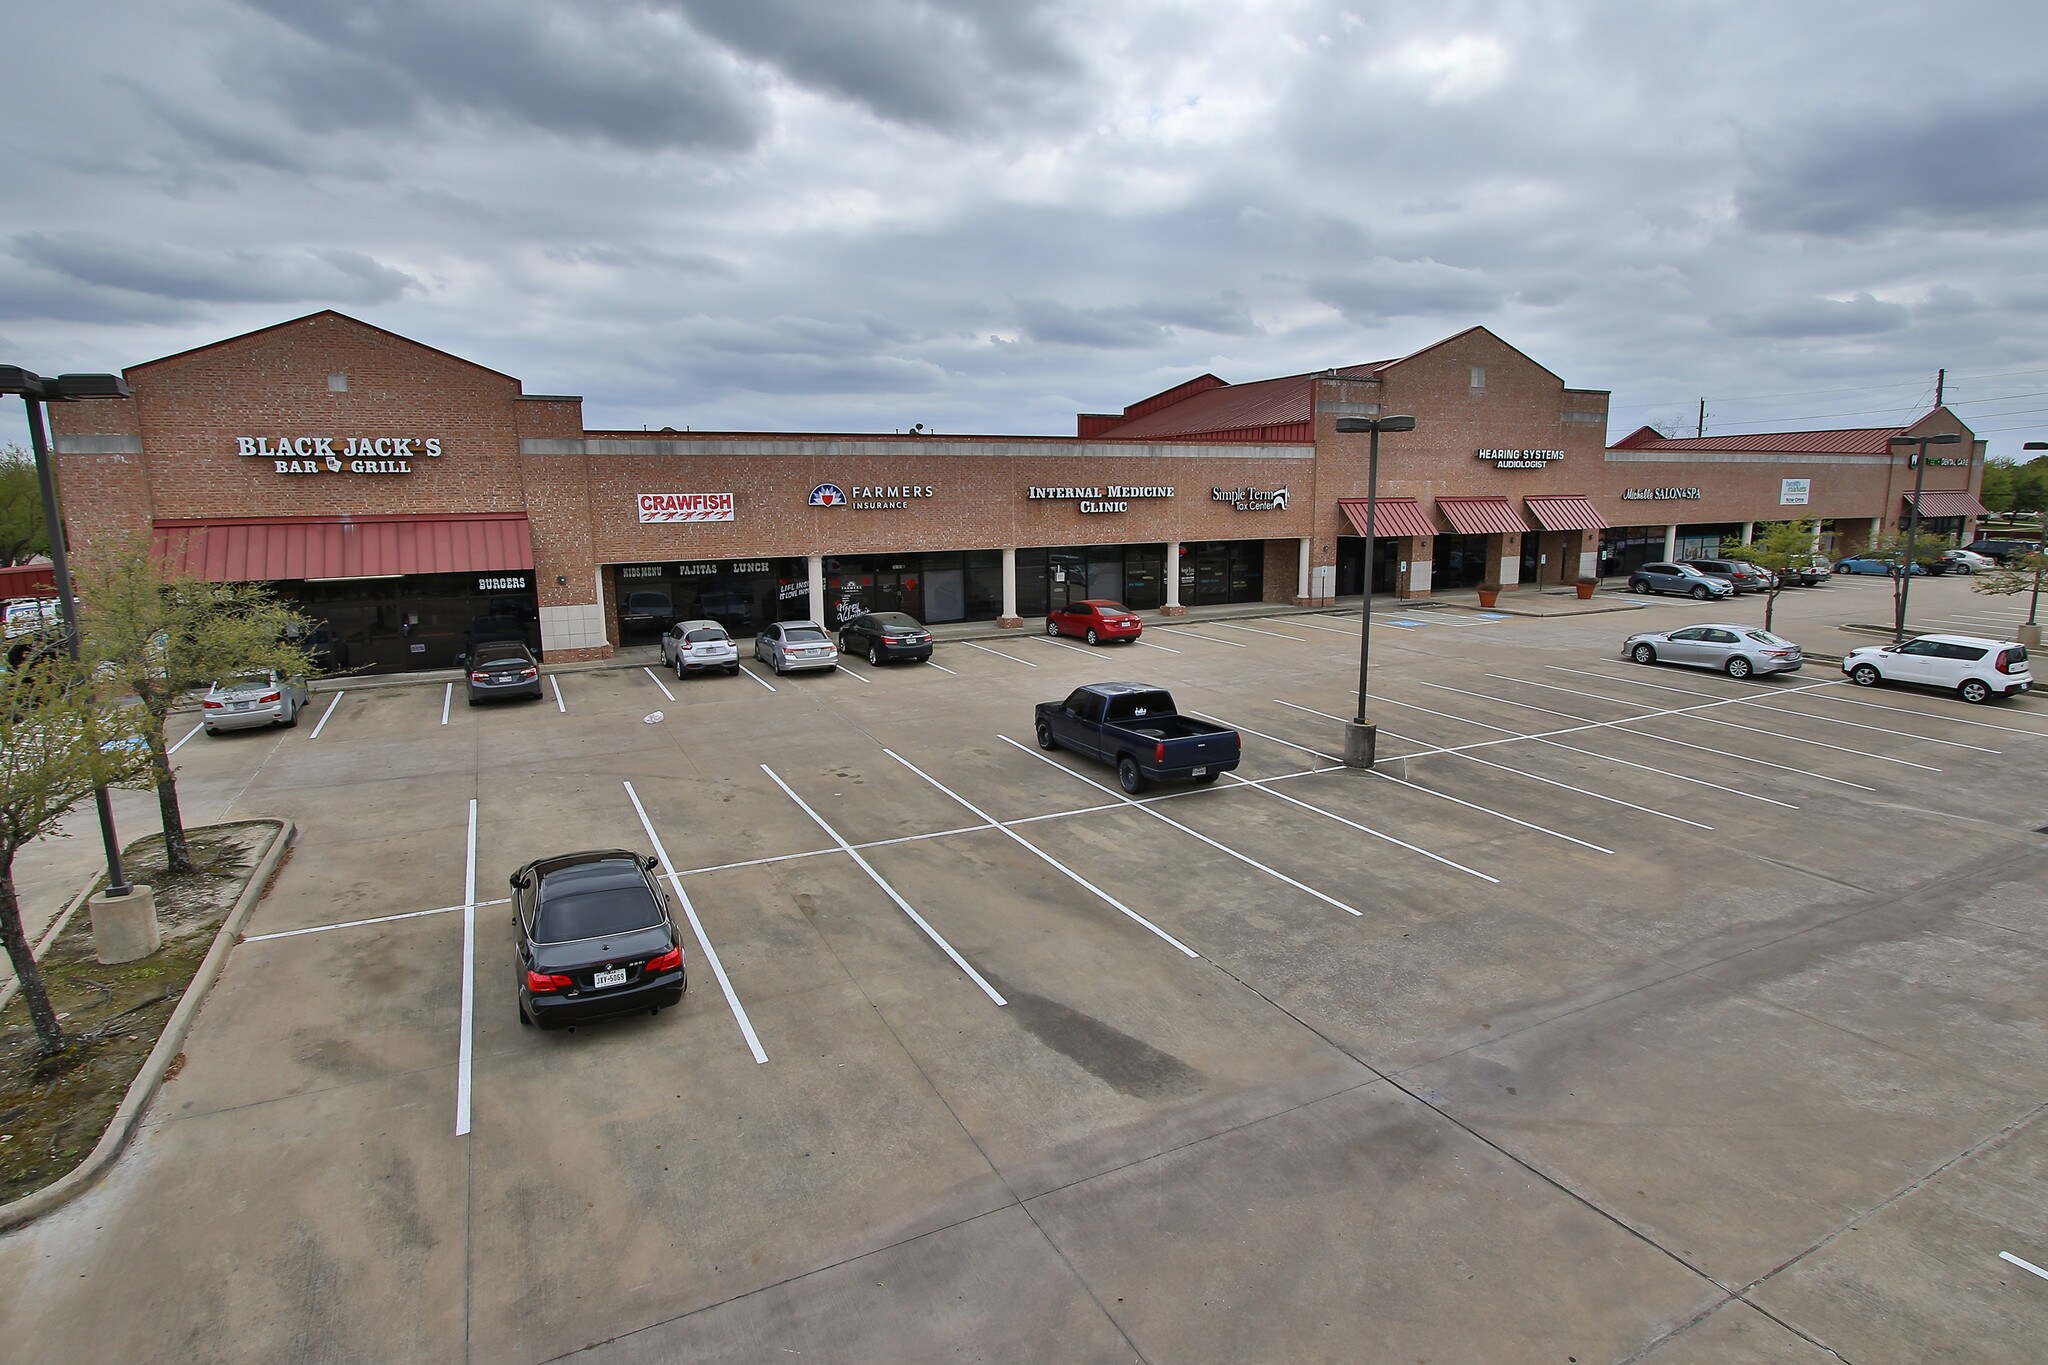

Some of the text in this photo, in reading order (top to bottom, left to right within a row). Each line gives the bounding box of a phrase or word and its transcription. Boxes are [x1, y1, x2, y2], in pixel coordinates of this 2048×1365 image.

[237, 436, 442, 457] BLACK JACK'S
[1478, 449, 1565, 460] HEARING SYSTEMS
[275, 460, 411, 473] BAR GRILL
[1497, 460, 1547, 469] AUDIOLOGIST
[852, 486, 934, 499] FARMERS
[1028, 485, 1175, 499] INTERNAL MEDICINE
[1212, 487, 1274, 505] Simple Term
[640, 494, 732, 512] CRAWFISH
[852, 501, 908, 510] INSURANCE
[1079, 500, 1128, 513] CLINIC
[1236, 501, 1274, 511] Tax Center
[680, 564, 717, 576] FAJITAS
[733, 562, 769, 574] LUNCH
[479, 577, 526, 590] BURGERS
